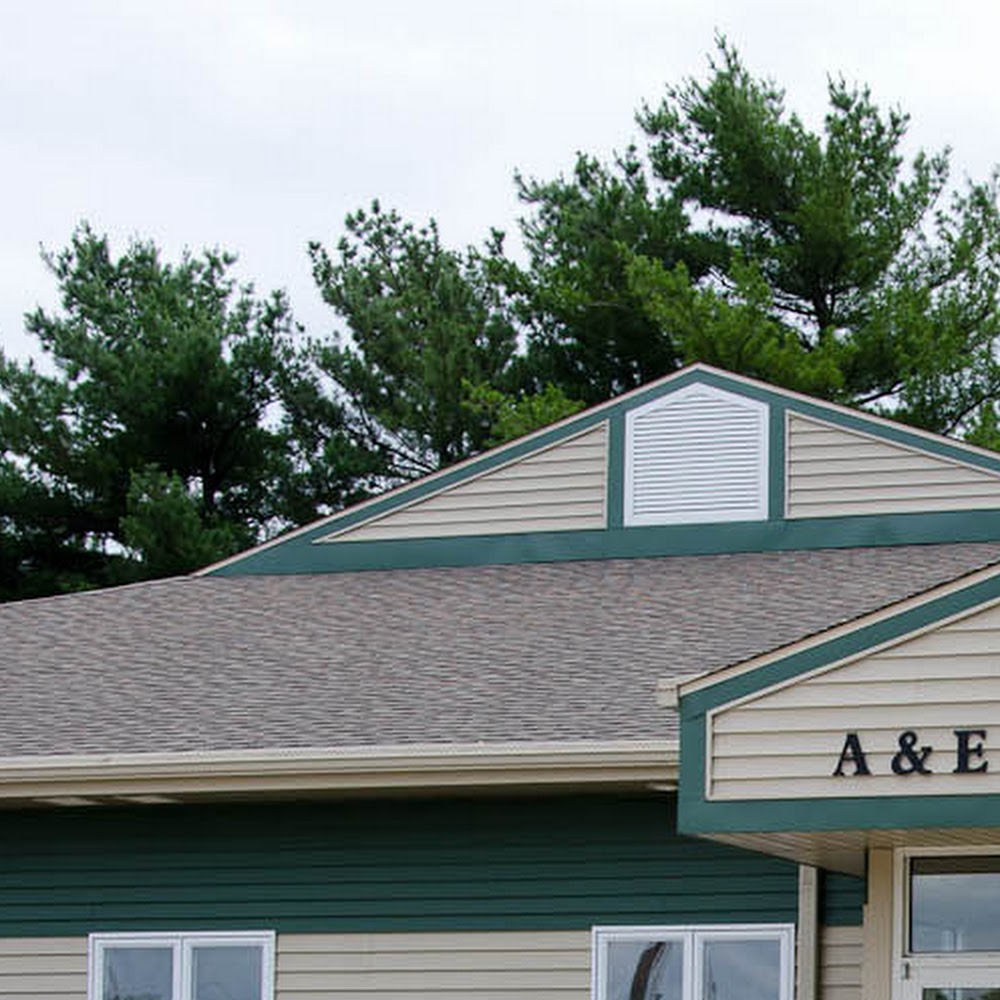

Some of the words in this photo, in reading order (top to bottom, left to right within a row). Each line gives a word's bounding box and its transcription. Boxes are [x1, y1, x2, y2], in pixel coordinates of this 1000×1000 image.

[832, 732, 873, 777] A
[890, 730, 932, 776] &
[952, 729, 989, 774] E
